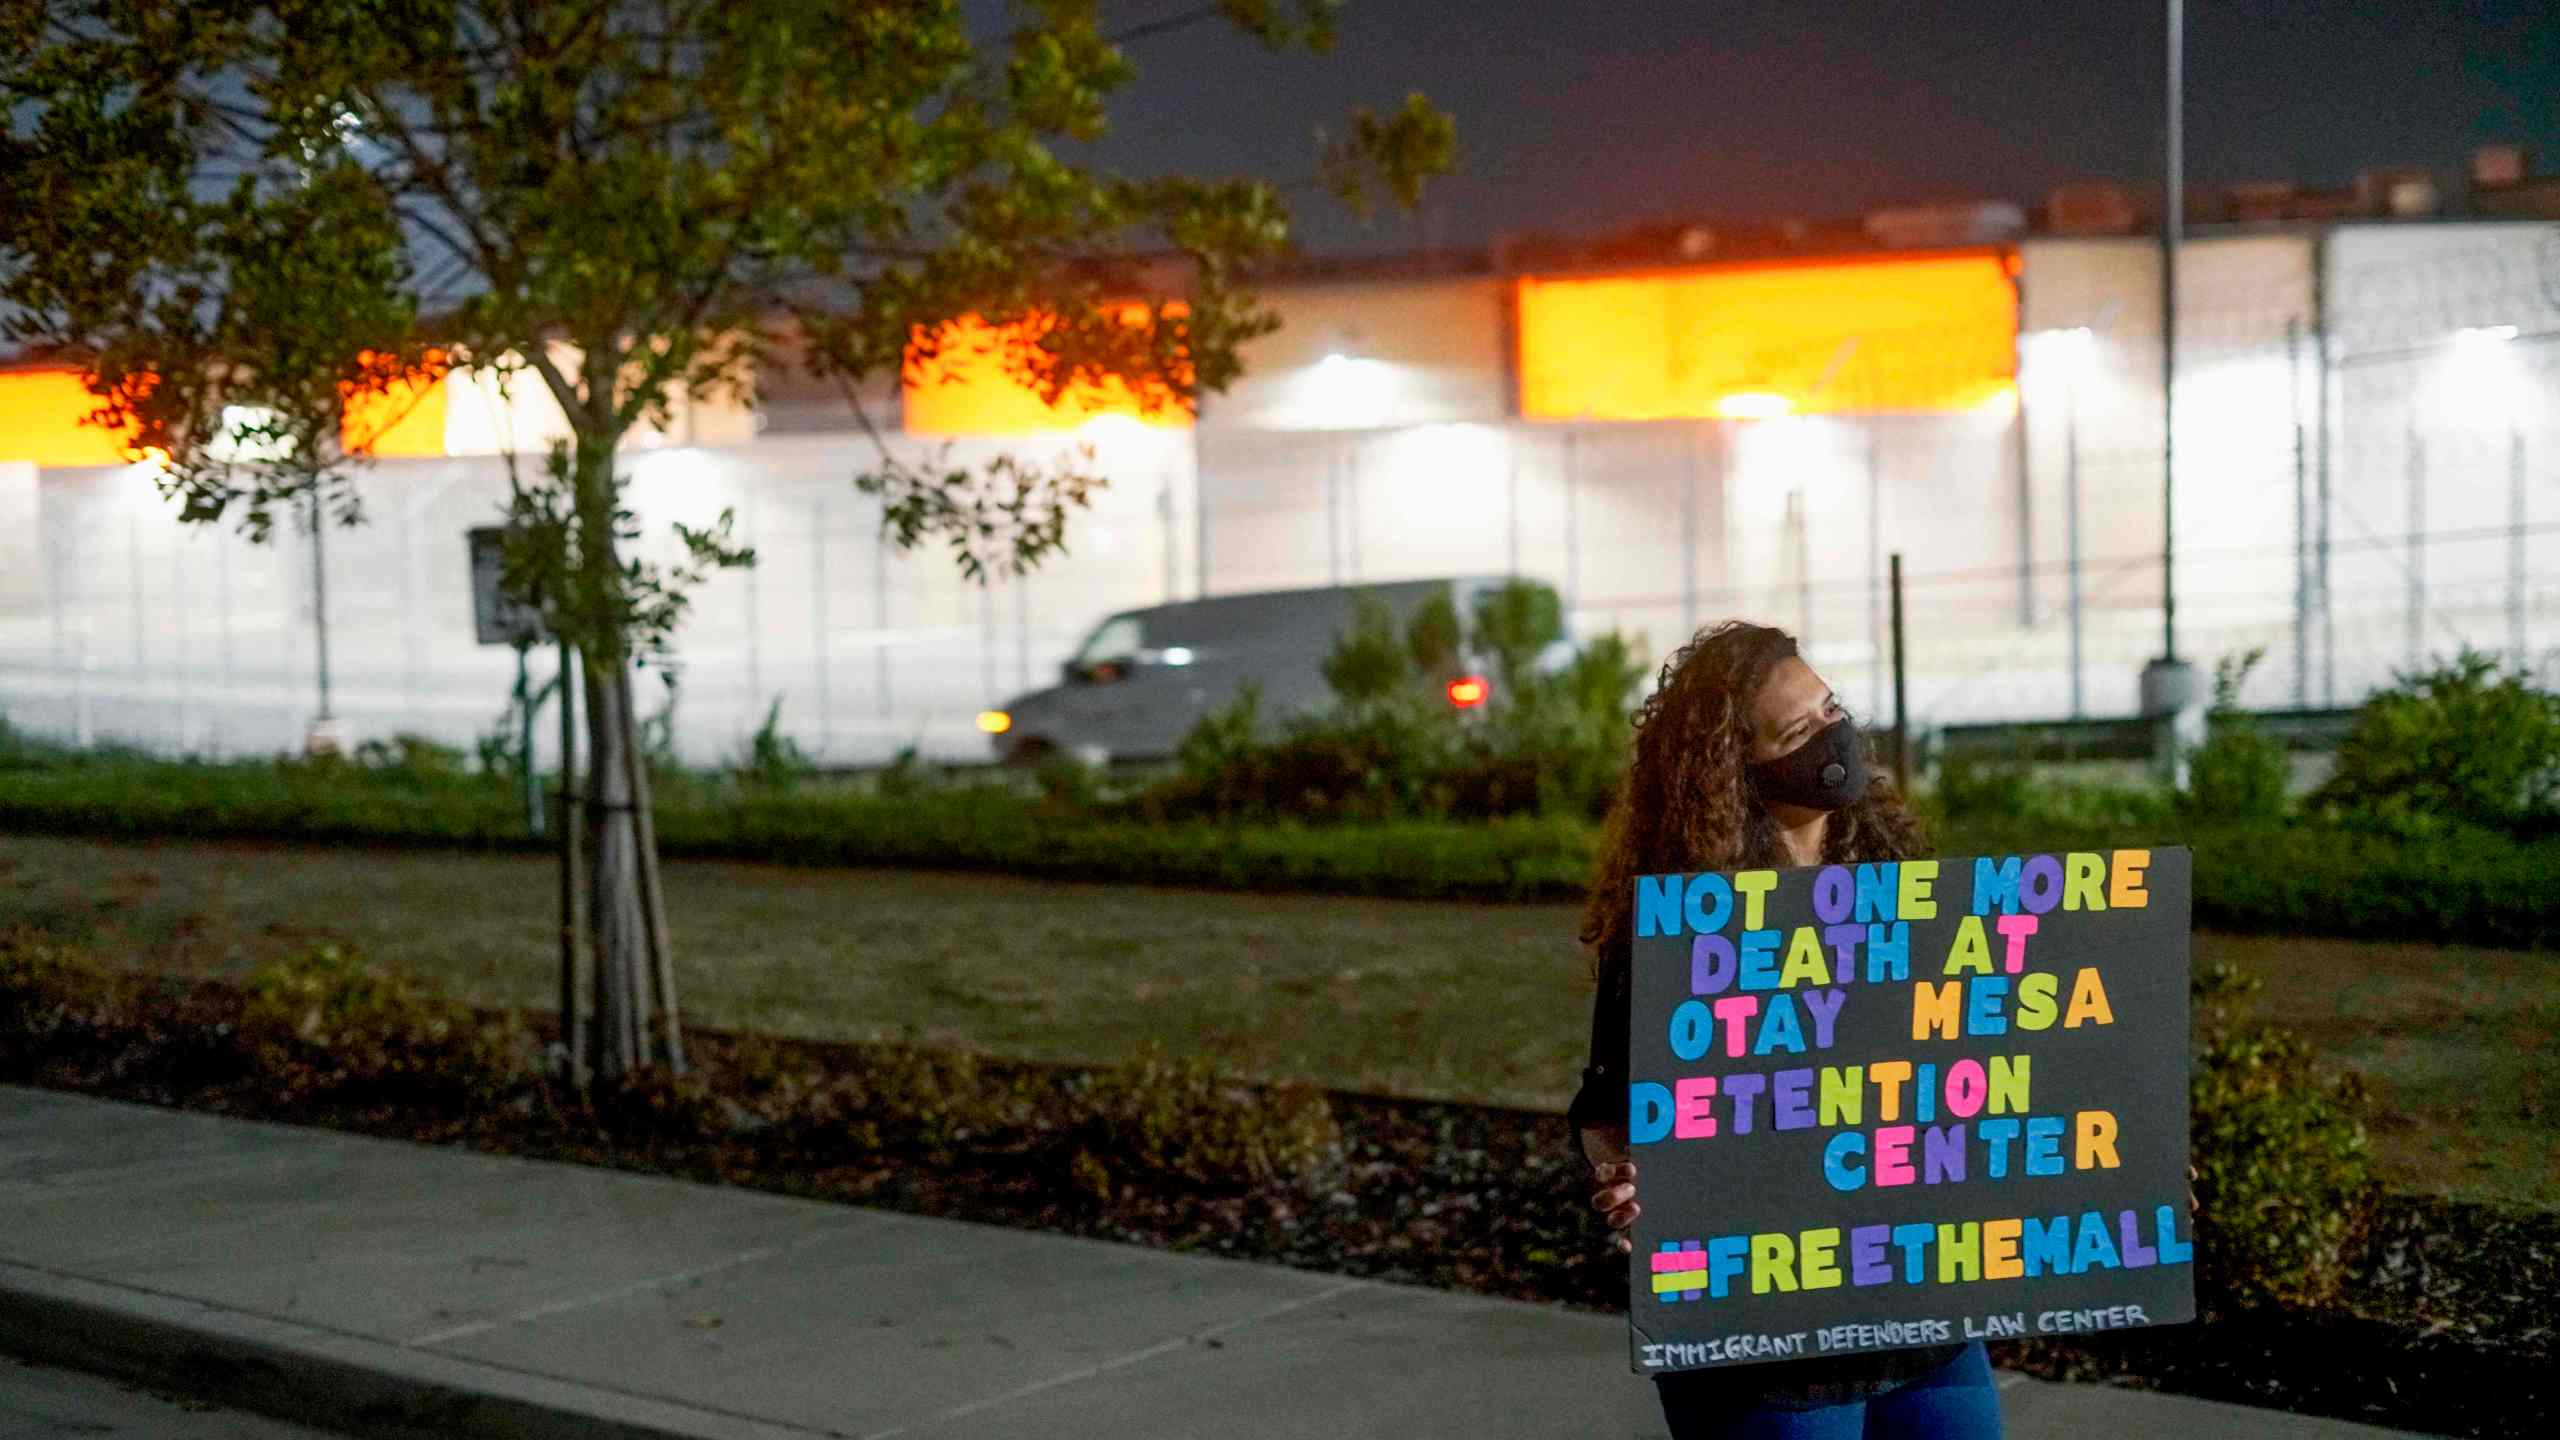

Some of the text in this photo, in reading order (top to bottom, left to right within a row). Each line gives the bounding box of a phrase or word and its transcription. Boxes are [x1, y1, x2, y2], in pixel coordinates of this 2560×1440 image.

[1637, 849, 2151, 937] NOT ONE MORE
[1690, 914, 2039, 995] DEATH AT
[1669, 967, 2114, 1060] OTAY MESA
[1629, 1055, 2031, 1145] DETENTION
[1823, 1110, 2121, 1192] CENTER
[1650, 1204, 2193, 1302] #FREETHEMALL
[1641, 1304, 2150, 1368] IMMIGRANT DEFENDERS LAW CENTER
